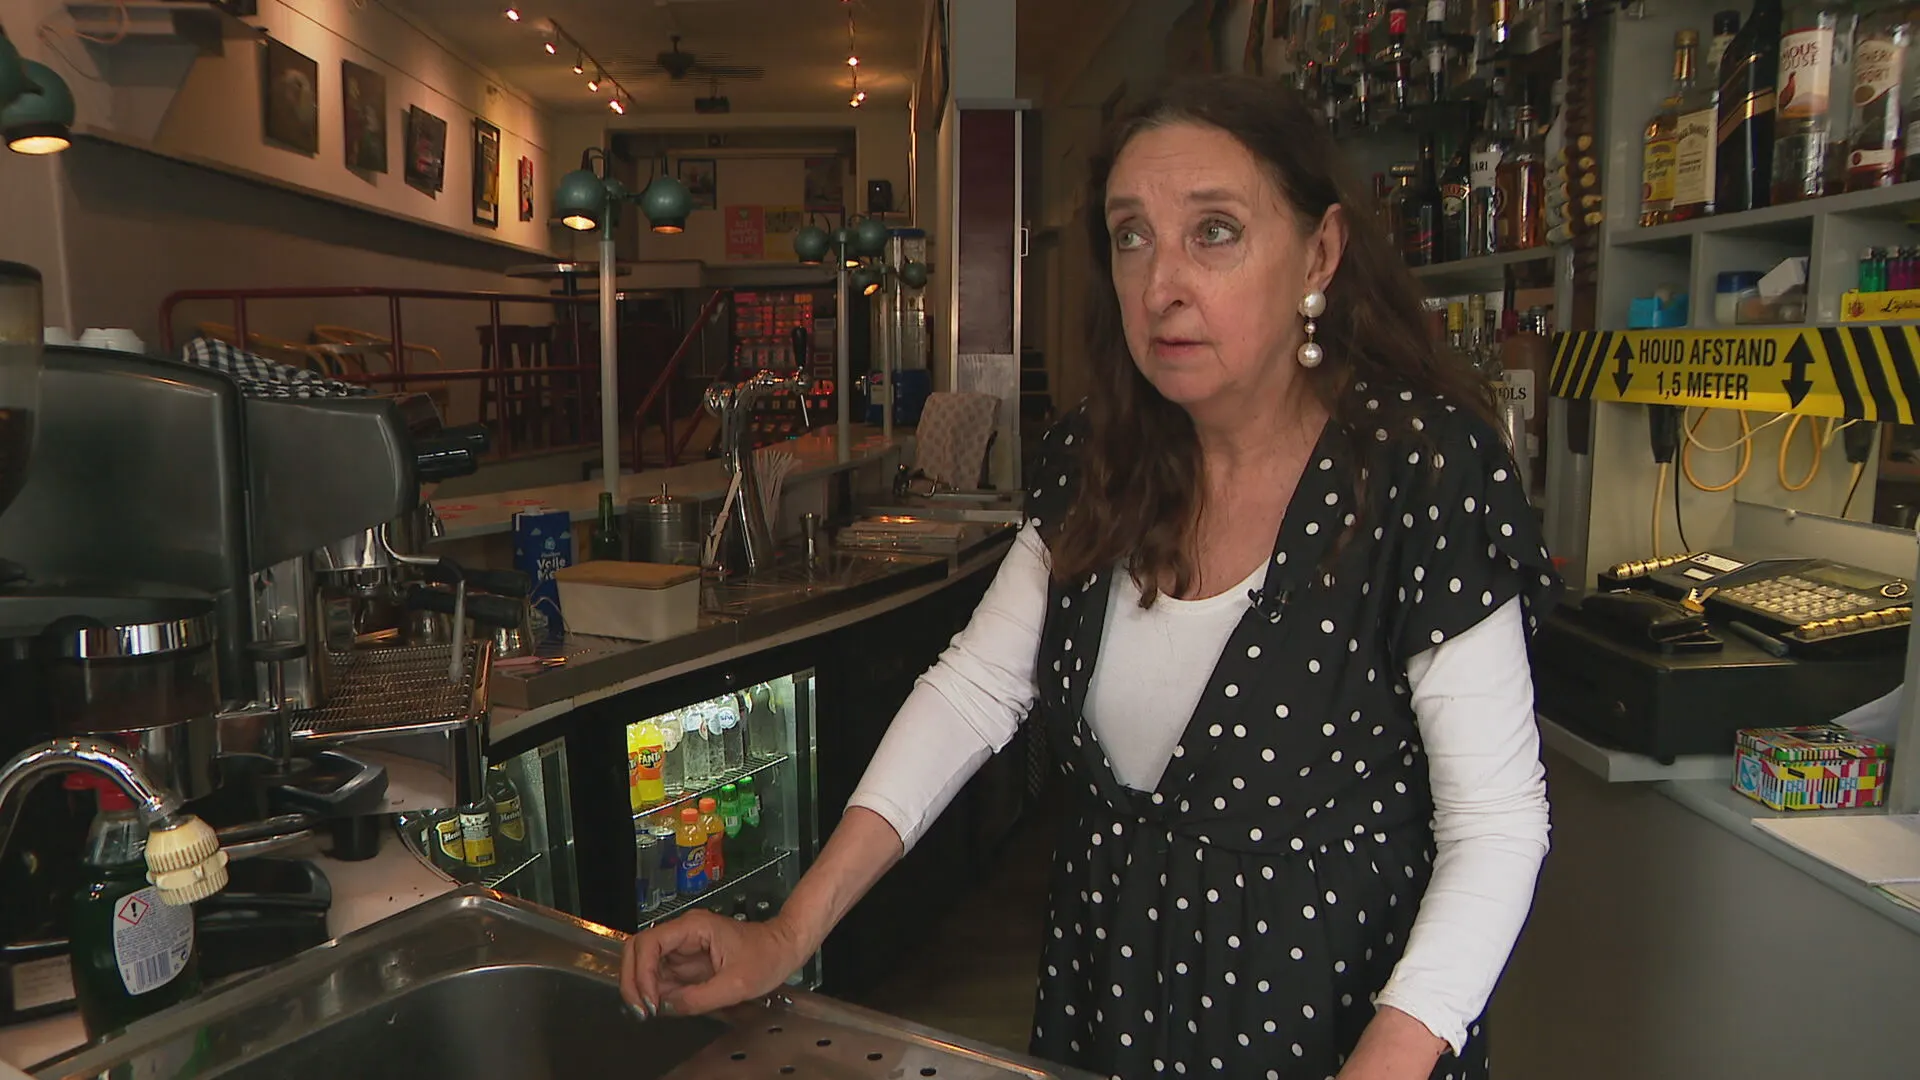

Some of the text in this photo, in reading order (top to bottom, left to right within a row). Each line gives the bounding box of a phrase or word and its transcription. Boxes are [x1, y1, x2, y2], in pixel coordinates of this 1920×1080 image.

[1639, 338, 1777, 366] HOUD AFSTAND
[1657, 371, 1748, 400] 1,5 METER
[536, 557, 566, 571] Volle
